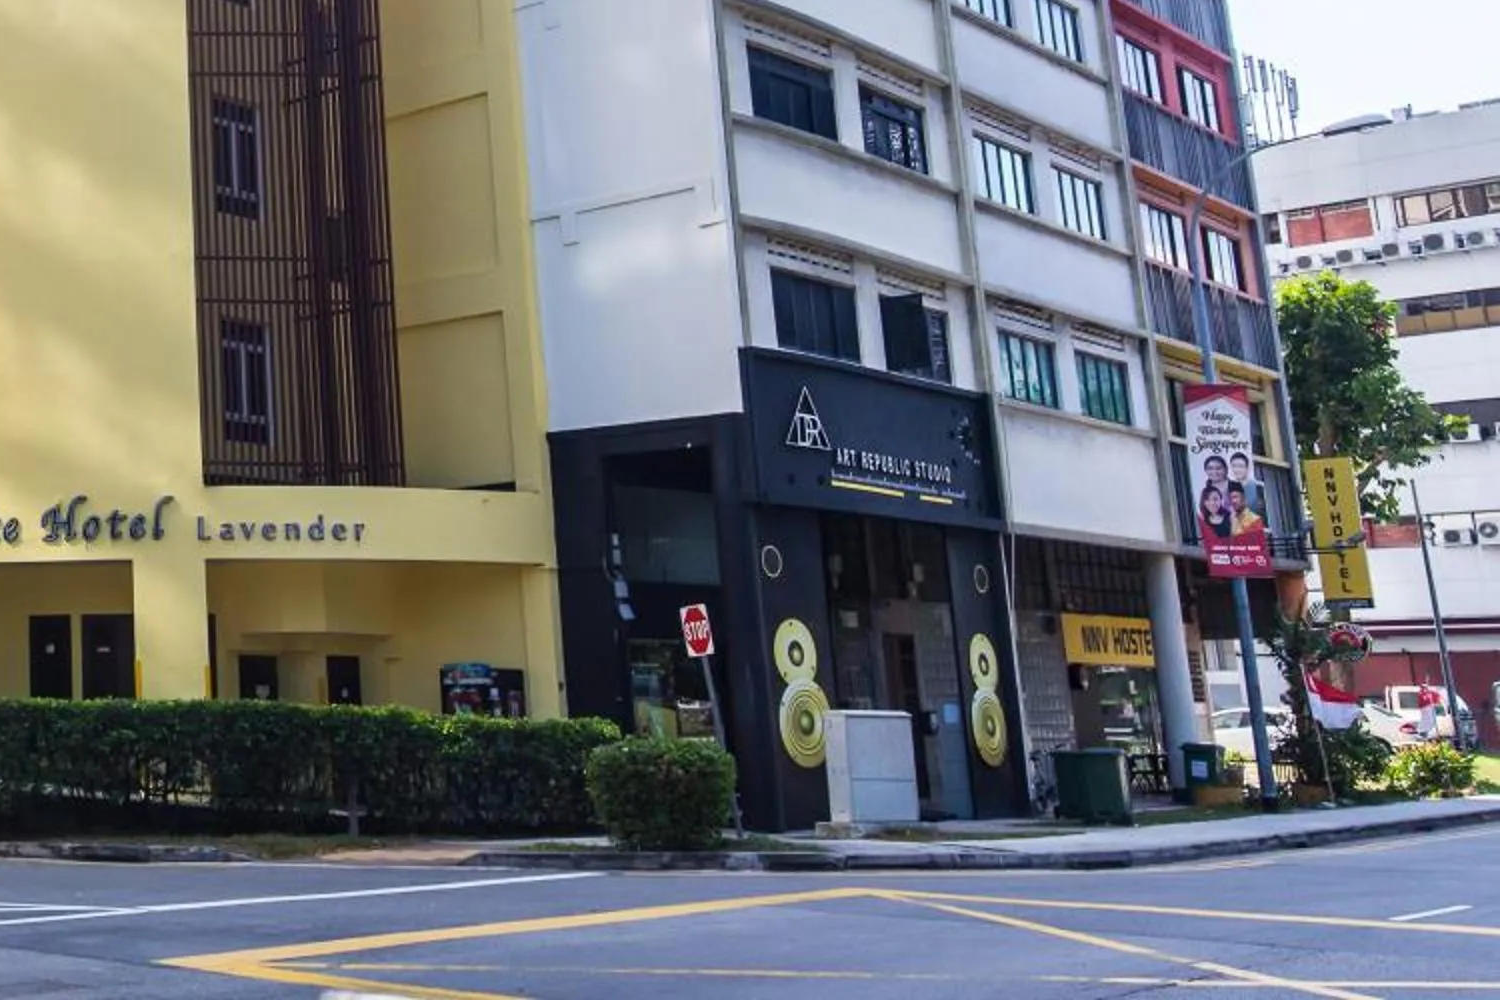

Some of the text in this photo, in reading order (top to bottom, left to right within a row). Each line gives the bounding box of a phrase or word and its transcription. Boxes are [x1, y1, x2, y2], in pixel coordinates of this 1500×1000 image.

[1191, 435, 1249, 454] Singapore
[837, 448, 952, 484] ART REPUBLIC STUDIO
[41, 495, 175, 542] Hotel
[197, 514, 365, 542] Lavender
[1330, 512, 1352, 593] HOTEL
[684, 620, 708, 641] STOP
[1082, 624, 1108, 654] NNV
